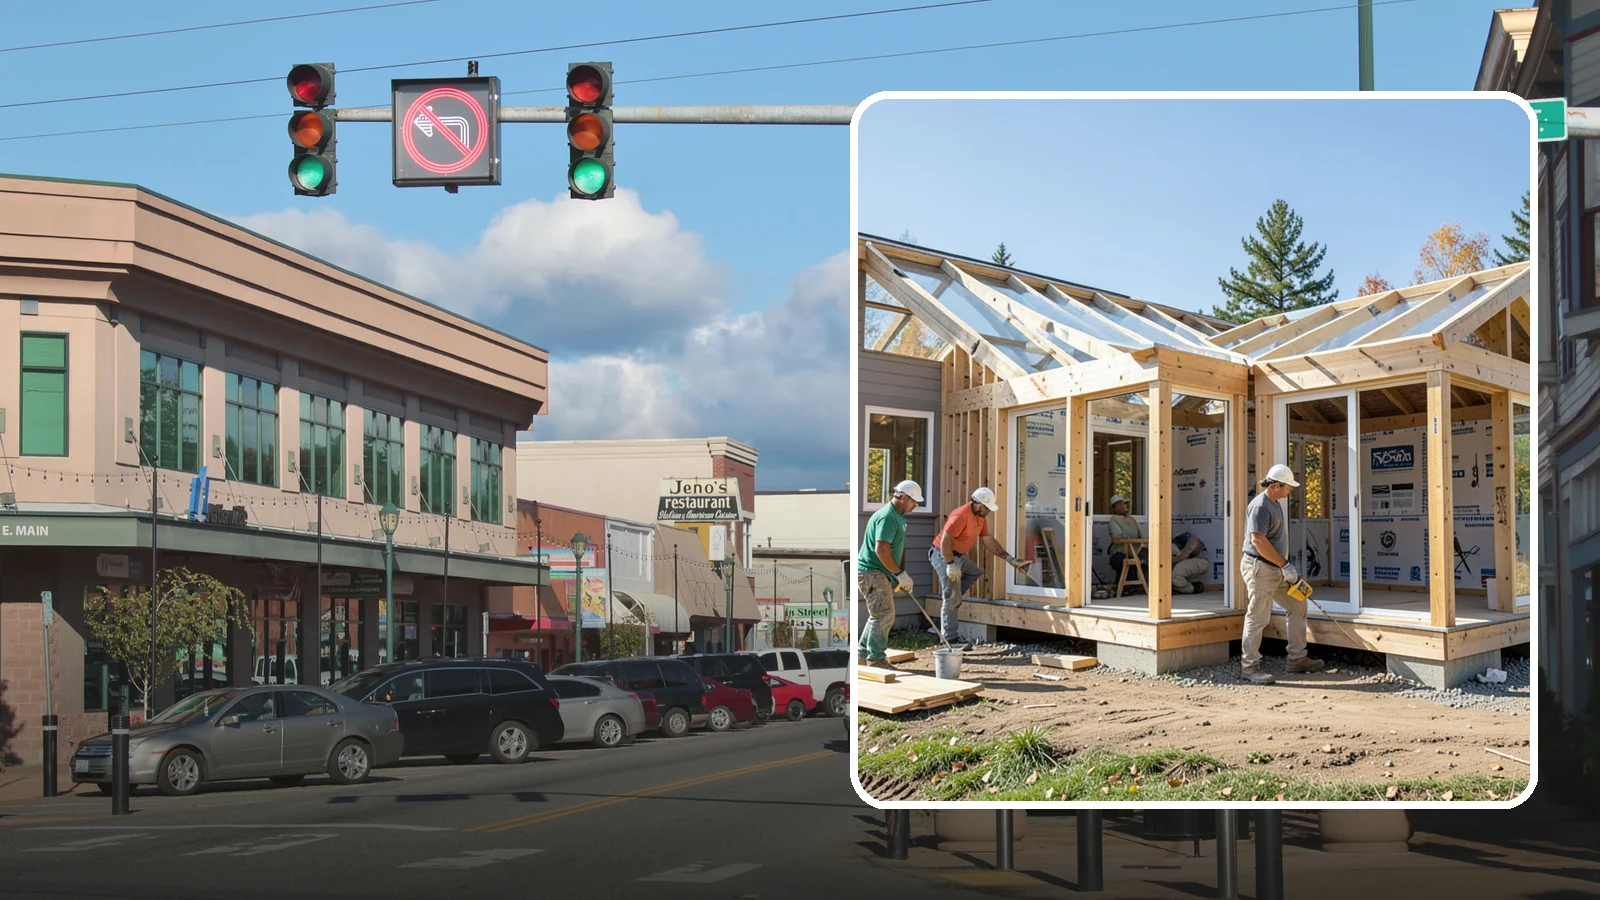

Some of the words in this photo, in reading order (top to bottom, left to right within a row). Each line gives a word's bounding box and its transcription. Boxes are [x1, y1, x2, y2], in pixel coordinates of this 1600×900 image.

[669, 479, 727, 495] Jeno's
[665, 496, 731, 509] restaurant
[685, 509, 714, 519] American
[714, 509, 737, 519] Cuisine
[2, 525, 13, 536] E.
[15, 525, 49, 536] MAIN
[797, 607, 829, 617] Street
[790, 619, 824, 628] lass
